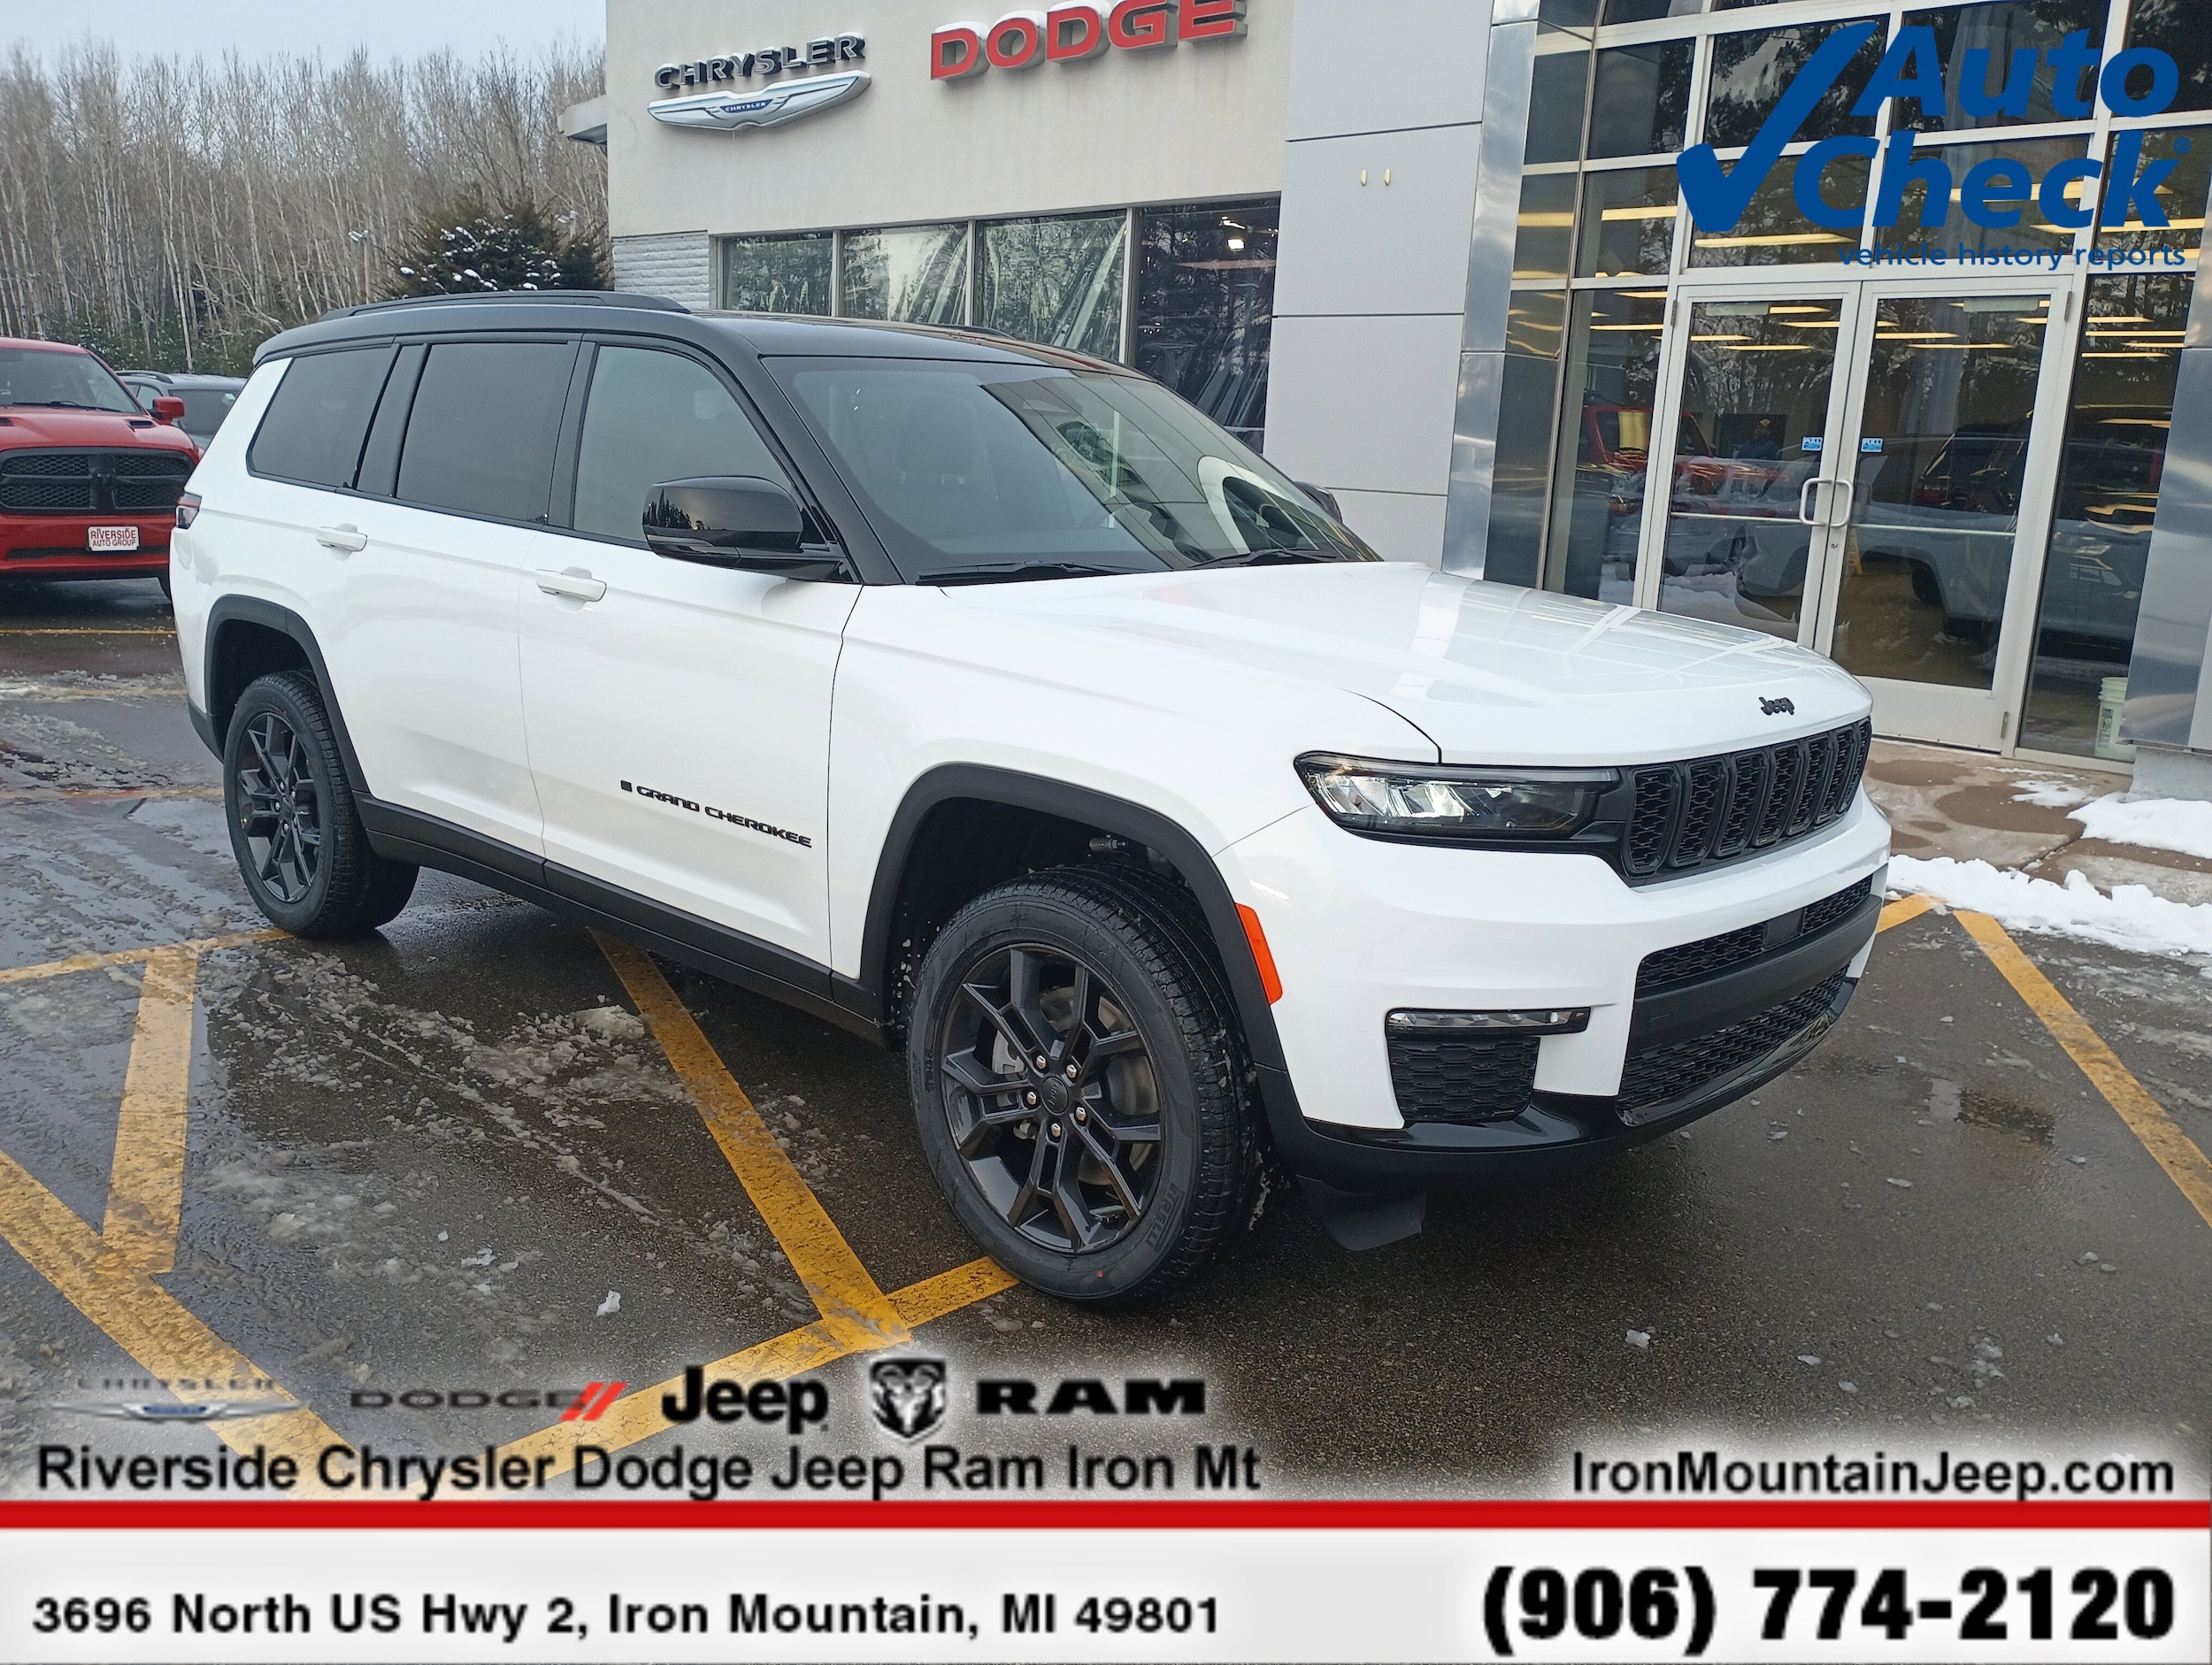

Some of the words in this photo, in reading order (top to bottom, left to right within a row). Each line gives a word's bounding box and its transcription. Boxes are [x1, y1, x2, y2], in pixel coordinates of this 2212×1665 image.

[931, 0, 1248, 81] DODGE
[654, 33, 865, 89] CHRYSLER
[725, 102, 766, 111] CHRYSLER
[90, 530, 136, 540] RIVERSIDE
[1758, 696, 1795, 716] Jeep
[636, 785, 700, 812] GRAND
[704, 806, 812, 848] CHEROKEE
